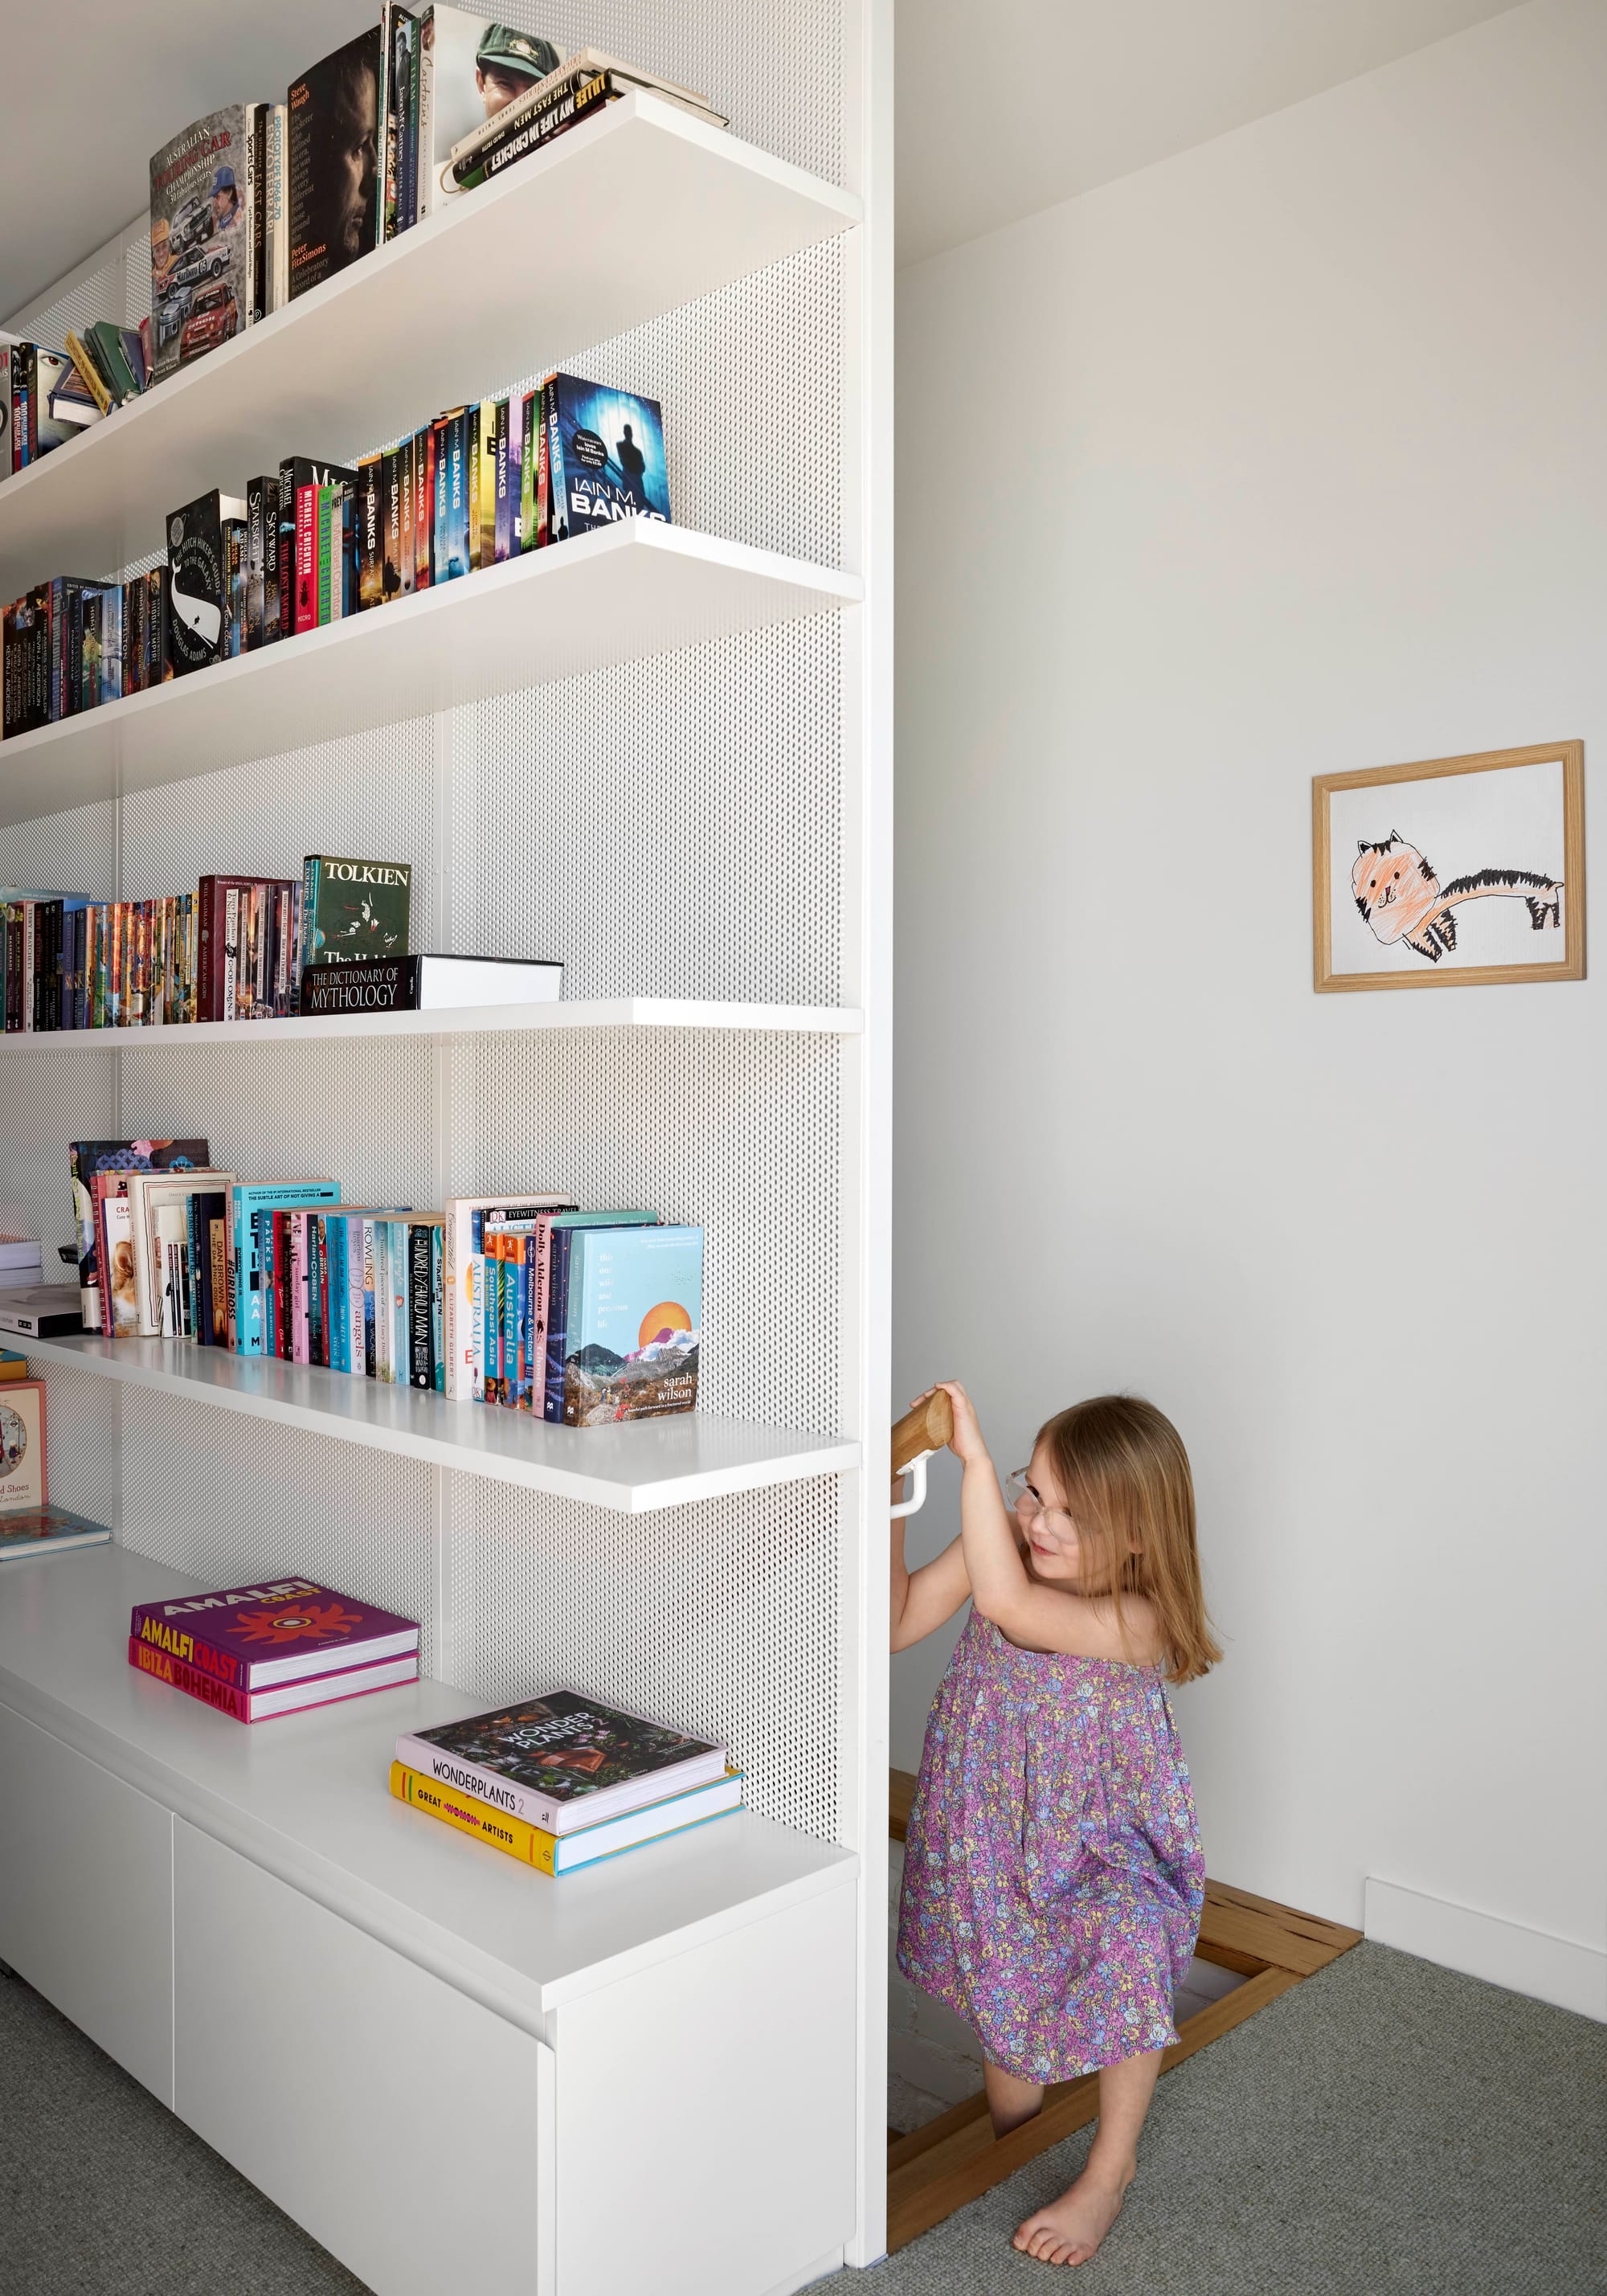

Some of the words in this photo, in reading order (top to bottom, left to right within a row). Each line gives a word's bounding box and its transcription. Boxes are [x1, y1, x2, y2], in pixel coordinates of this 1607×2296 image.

[291, 83, 306, 100] Steve
[291, 89, 309, 110] Waugh
[533, 90, 553, 116] FAST
[552, 81, 569, 100] THE
[575, 73, 607, 109] LILLEE
[513, 111, 533, 130] MEN
[540, 110, 561, 135] LIFE
[560, 96, 575, 122] MY
[166, 126, 211, 168] AUSTRALIAN
[266, 124, 274, 169] ENZO
[482, 140, 493, 153] FRITH
[493, 131, 505, 145] DAVID
[530, 122, 542, 143] IN
[154, 145, 199, 192] TOURING
[200, 130, 231, 157] CAR
[491, 133, 530, 171] CRICKET
[166, 153, 215, 195] CHAMPIONSHIP
[170, 194, 177, 204] 30
[176, 178, 197, 199] fabulous
[196, 170, 212, 186] years
[266, 174, 274, 235] FERRARI
[292, 243, 308, 259] Peter
[292, 244, 326, 270] FitzSimons
[550, 412, 562, 475] BANKS
[576, 444, 587, 453] Iain
[590, 448, 605, 458] Banks
[583, 441, 597, 450] loves
[452, 449, 460, 510] BANKS
[498, 437, 506, 499] BANKS
[284, 468, 292, 508] MICHAEL
[331, 494, 342, 511] PREY
[575, 477, 611, 499] IAIN
[615, 489, 637, 505] M.
[304, 489, 312, 529] MICHAEL
[249, 492, 261, 564] STARSIGHT
[266, 511, 276, 572] SKYWARD
[303, 531, 312, 575] CRICHTON
[333, 524, 341, 570] Michael
[182, 536, 197, 550] HITCH
[198, 537, 215, 563] HIKER'S
[211, 563, 221, 596] GUIDE
[184, 559, 189, 569] TO
[189, 555, 197, 567] THE
[197, 556, 212, 591] GALAXY
[333, 569, 341, 621] Crichton
[297, 614, 311, 623] MICRO
[172, 618, 190, 661] DOUGLAS
[189, 648, 206, 662] ADAMS
[325, 862, 410, 887] TOLKIEN
[313, 972, 327, 986] THE
[329, 967, 386, 986] DICTIONARY
[386, 967, 399, 982] OF
[311, 984, 399, 1009] MYTHOLOGY
[491, 1213, 505, 1221] DK
[509, 1208, 550, 1219] EYEWITNESS
[364, 1226, 374, 1285] ROWLING
[447, 1212, 456, 1271] Committed
[536, 1223, 546, 1255] Dolly
[537, 1258, 545, 1312] Alderton
[472, 1259, 481, 1357] AUSTRALIA
[505, 1273, 515, 1365] Australia
[354, 1310, 364, 1358] angels
[535, 1345, 544, 1389] Ghosts
[664, 1374, 693, 1387] sarah
[657, 1386, 693, 1402] wilson
[0, 1494, 31, 1504] London
[7, 1484, 30, 1493] Shoes
[163, 1581, 315, 1617] AMALFI
[260, 1588, 322, 1604] COAST
[141, 1616, 194, 1663] AMALFI
[194, 1642, 238, 1684] COAST
[138, 1645, 173, 1683] IBIZA
[174, 1663, 239, 1713] BOHEMIA
[497, 1712, 596, 1744] WONDER
[515, 1722, 595, 1750] PLANTS
[591, 1717, 610, 1726] 2
[432, 1758, 516, 1811] WONDERPLANTS
[517, 1798, 525, 1816] 2
[417, 1788, 442, 1808] GREAT
[482, 1820, 513, 1844] ARTISTS
